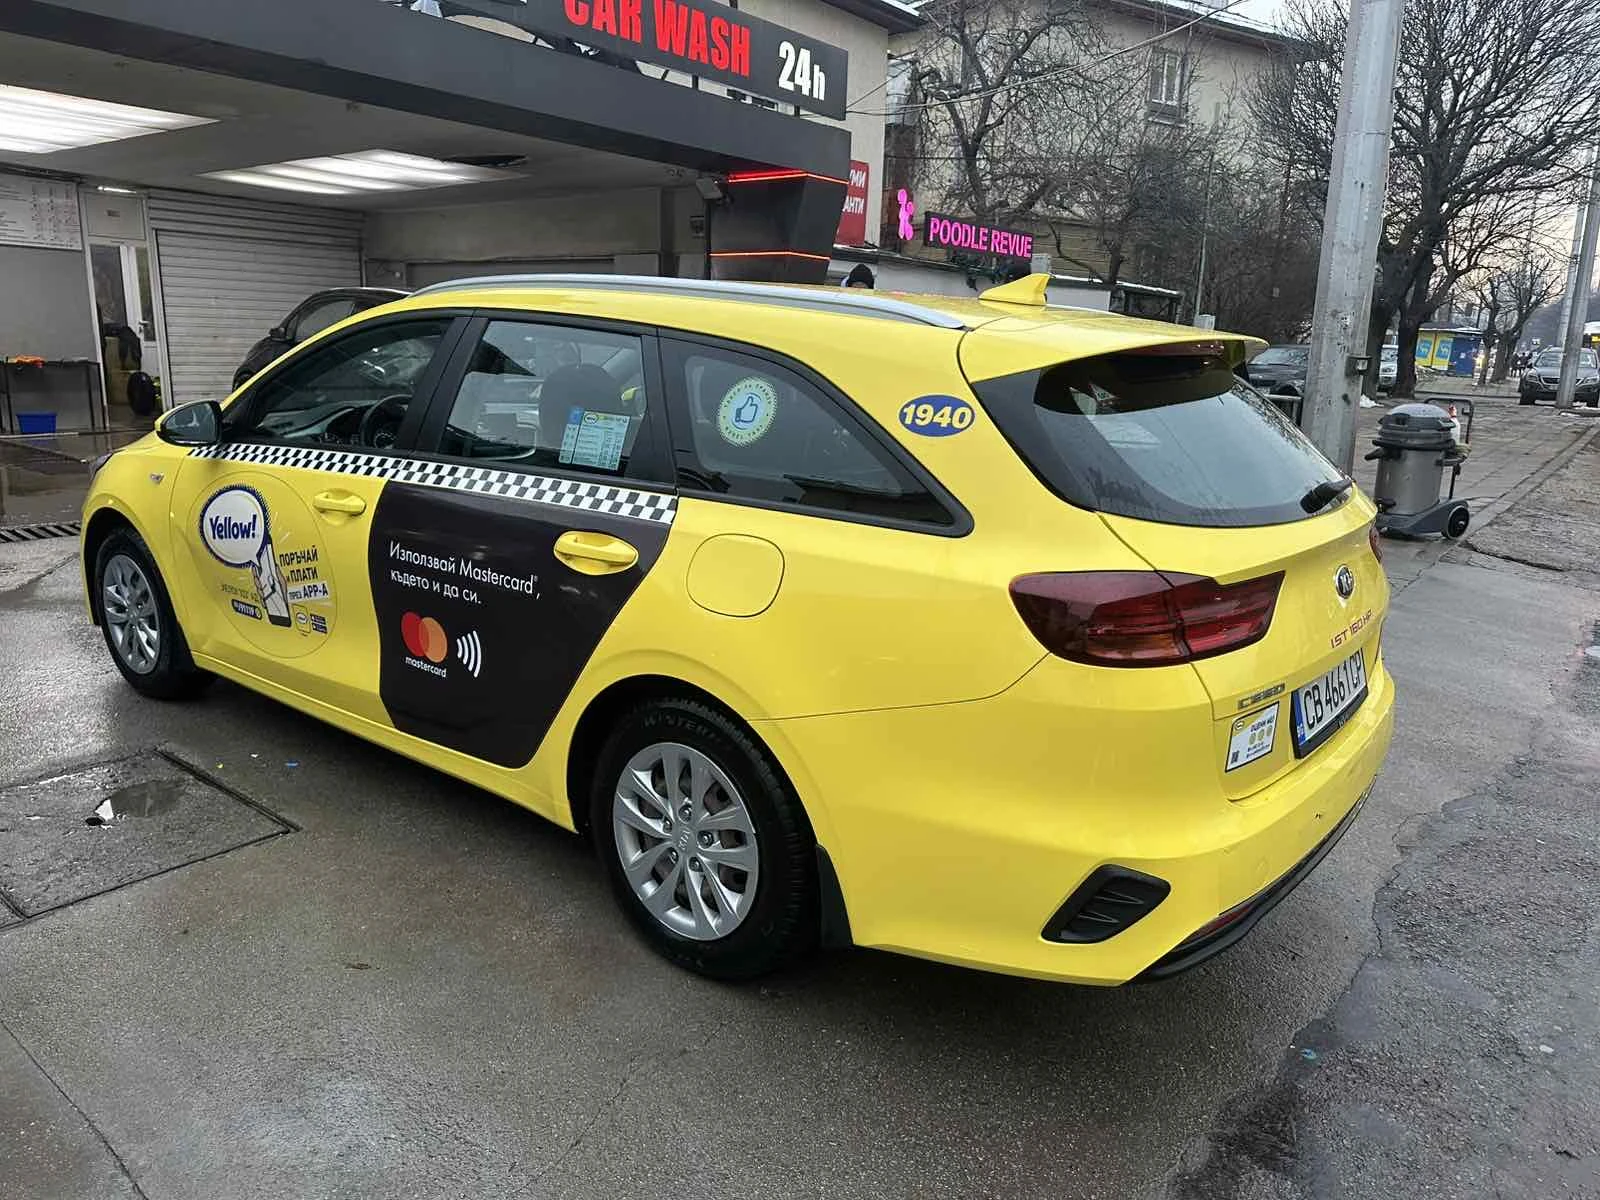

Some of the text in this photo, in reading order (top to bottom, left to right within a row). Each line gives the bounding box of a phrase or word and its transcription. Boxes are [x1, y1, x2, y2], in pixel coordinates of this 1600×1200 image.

[564, 0, 826, 101] CAR WASH 24h
[842, 195, 865, 214] АНТИ
[929, 217, 1033, 258] POODLE REVUE
[903, 403, 973, 429] 1940
[209, 514, 257, 540] Yellow!
[279, 545, 319, 567] ПОРЪЧАЙ
[389, 540, 457, 575] Използвай
[289, 566, 319, 583] ПЛАТИ
[390, 569, 482, 605] където и да си.
[405, 656, 448, 678] mastercard
[1325, 660, 1351, 713] 4661
